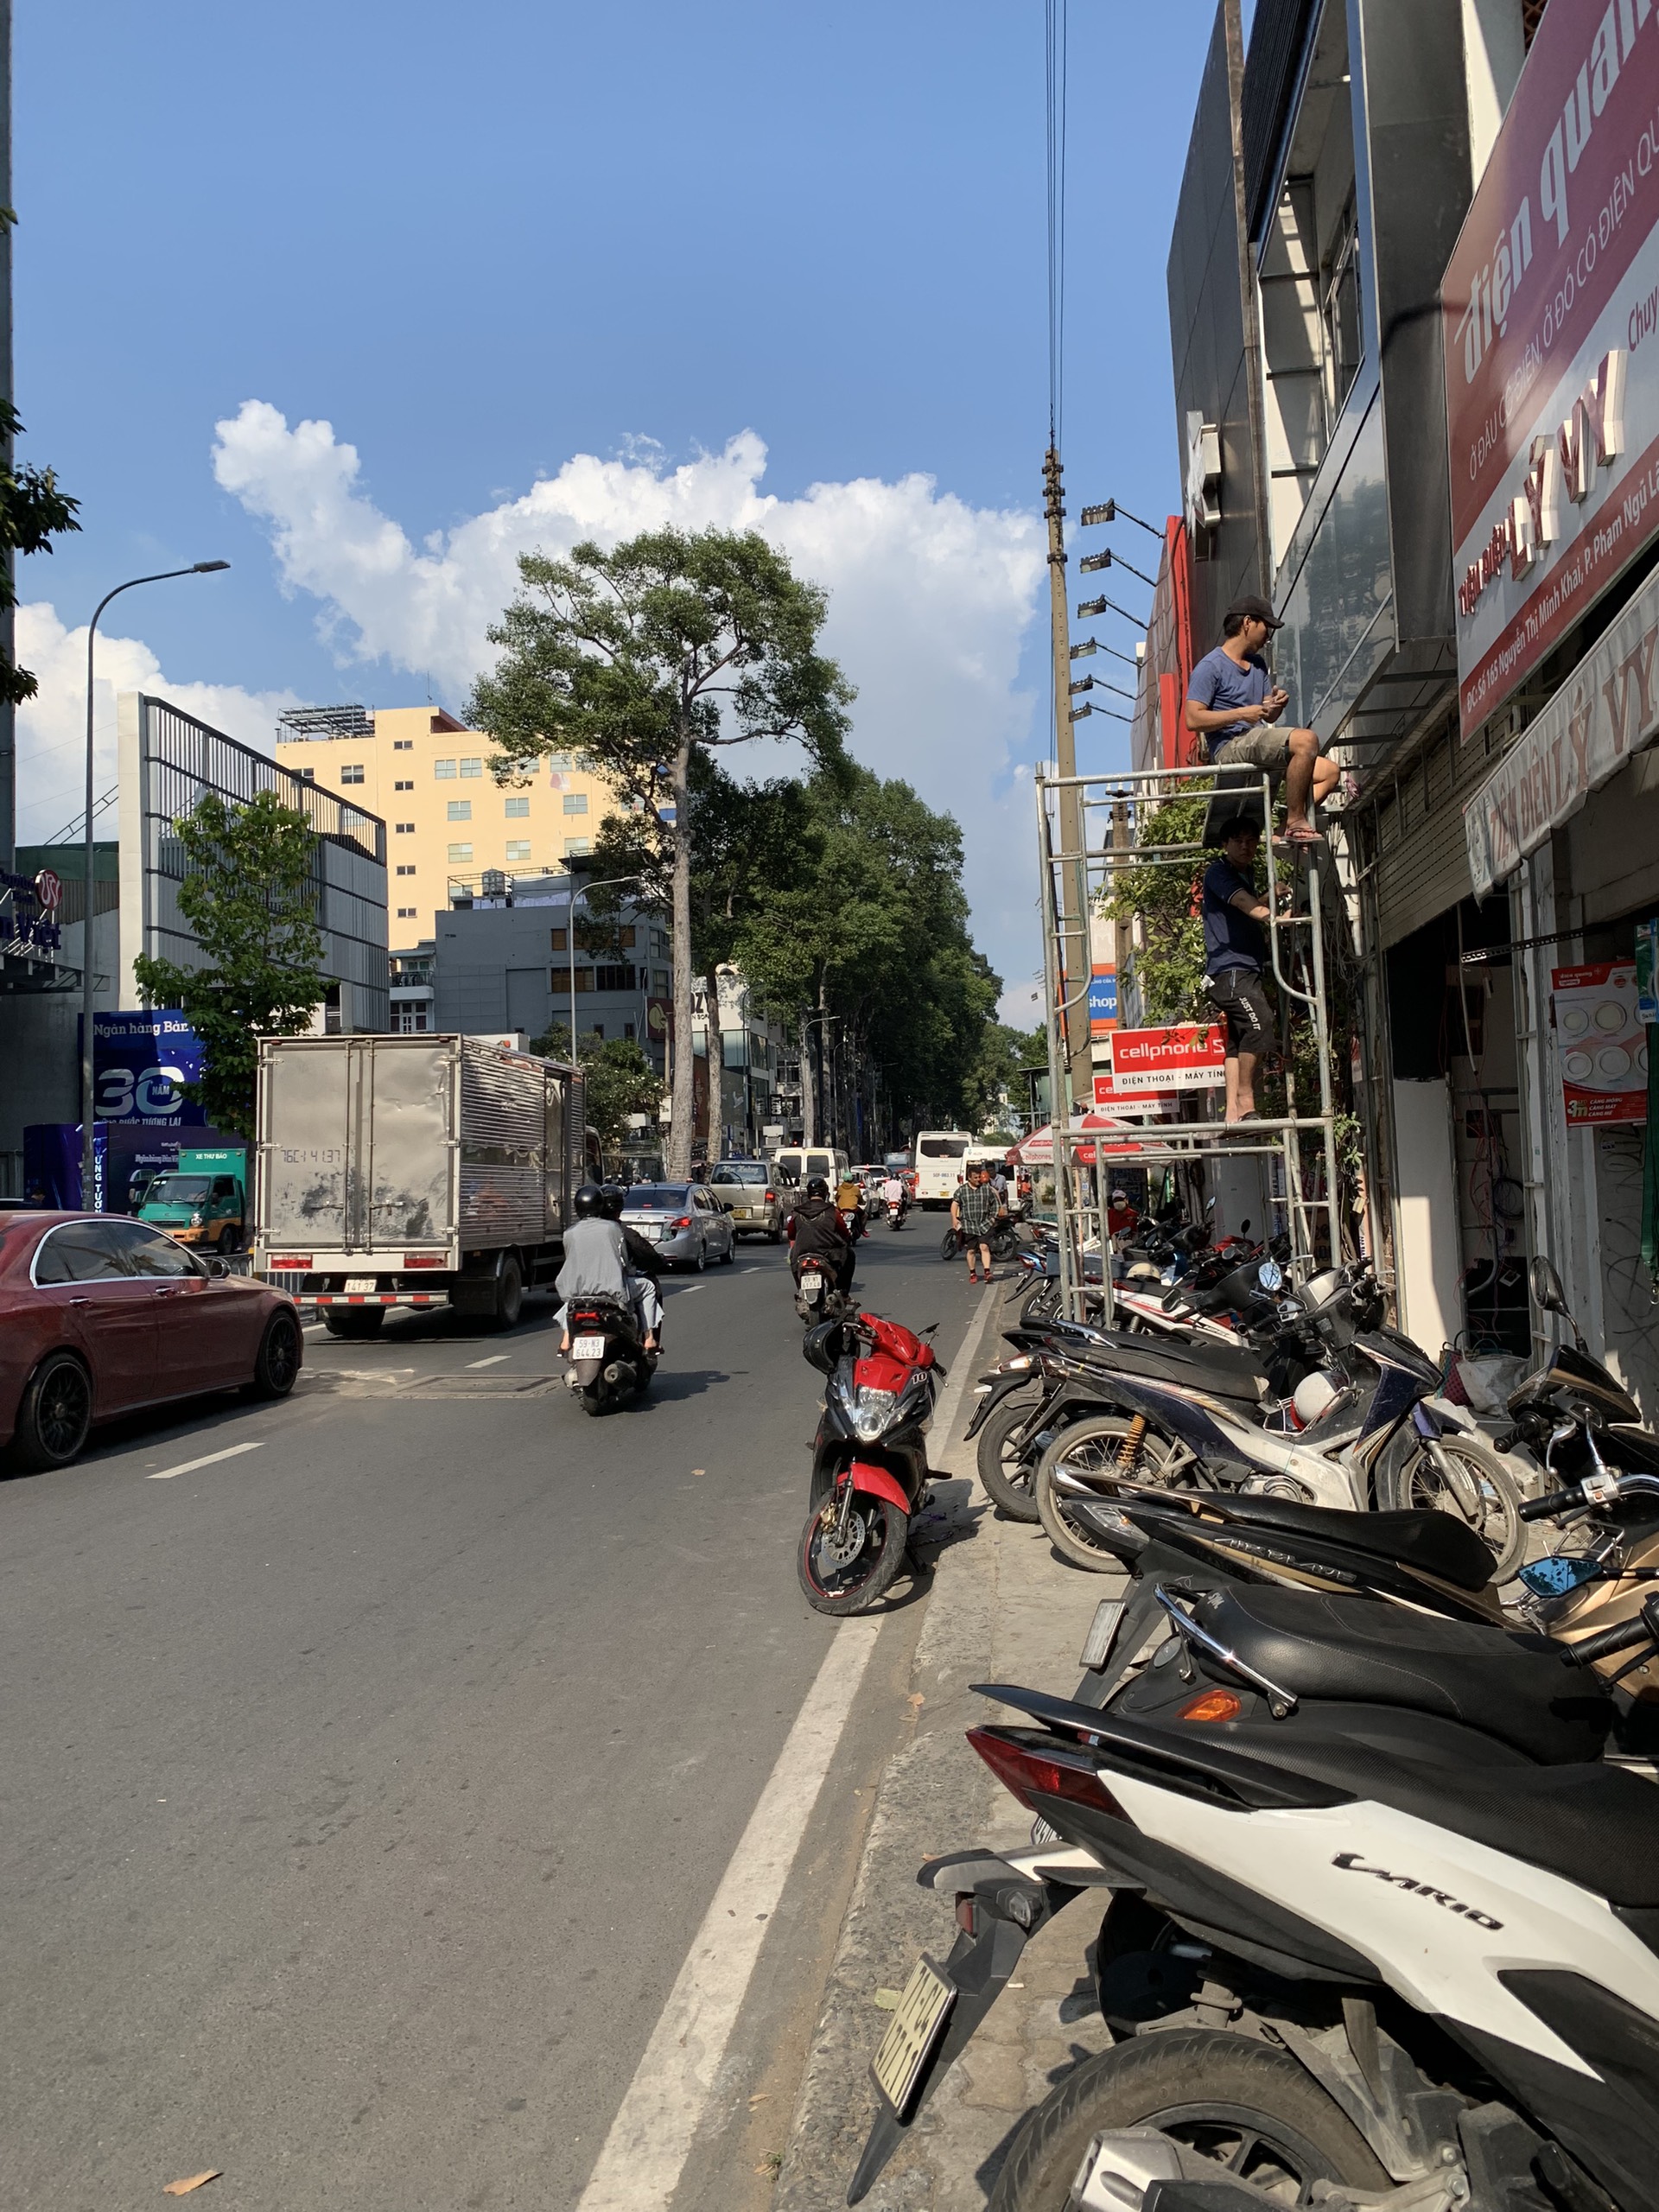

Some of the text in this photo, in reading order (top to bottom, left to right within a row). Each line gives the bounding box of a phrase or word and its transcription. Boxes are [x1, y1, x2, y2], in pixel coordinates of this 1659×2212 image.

[1454, 196, 1533, 384] điện
[1470, 444, 1477, 480] Ở
[1478, 410, 1497, 467] ĐÂU
[1543, 304, 1553, 348] Ở
[1554, 265, 1574, 330] ĐÓ
[1577, 225, 1597, 288] CÓ
[1599, 159, 1635, 251] ĐIỆN
[1525, 608, 1539, 642] Thị
[1538, 585, 1560, 628] Minh
[1560, 557, 1584, 602] Khai,
[1584, 546, 1592, 575] P.
[1593, 515, 1623, 563] Phạm
[1623, 478, 1648, 528] Ngũ
[1552, 685, 1593, 813] LÝ
[1601, 623, 1659, 756] VY
[94, 1024, 127, 1038] Ngân
[129, 1022, 161, 1036] hàng
[1238, 996, 1254, 1012] JUST
[1249, 1012, 1258, 1023] DO
[95, 1066, 185, 1116] 30
[152, 1085, 170, 1096] NĂM
[1122, 1070, 1226, 1085] ĐIỆN THOẠI MÁY TÍN
[911, 1371, 928, 1384] 10
[1332, 1853, 1504, 1931] VARIO
